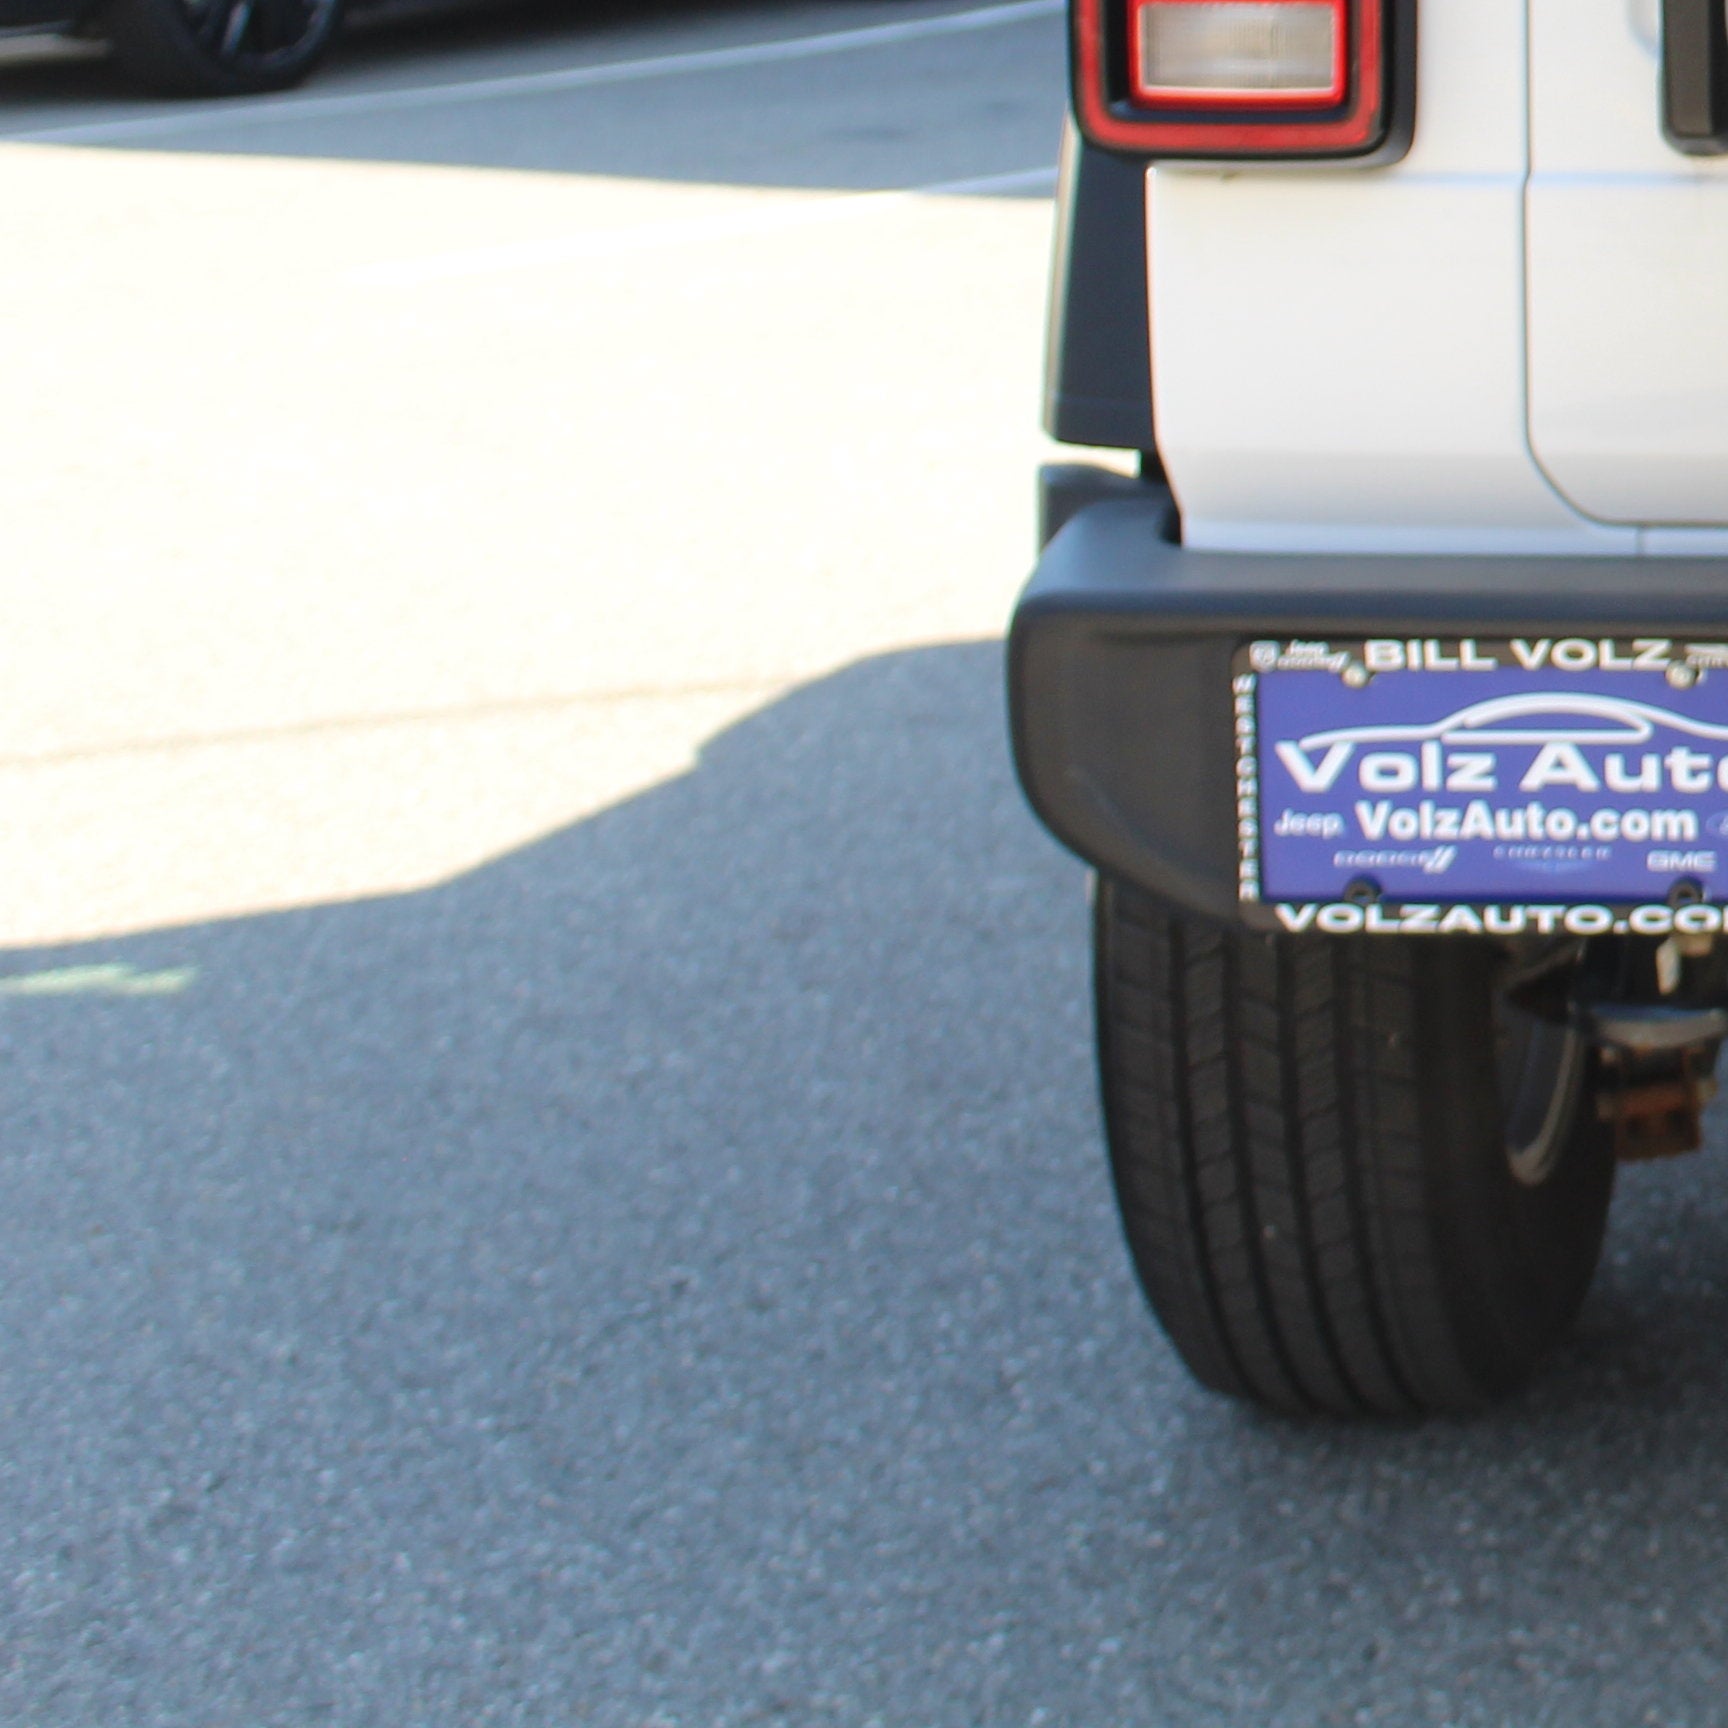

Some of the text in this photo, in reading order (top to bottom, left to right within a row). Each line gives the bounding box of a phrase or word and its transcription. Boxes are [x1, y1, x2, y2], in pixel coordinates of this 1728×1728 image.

[1364, 638, 1498, 671] BILL
[1509, 638, 1672, 672] VOLZ
[1275, 740, 1498, 793] Volz
[1273, 808, 1345, 839] Jeep
[1354, 799, 1698, 842] VolzAuto.com
